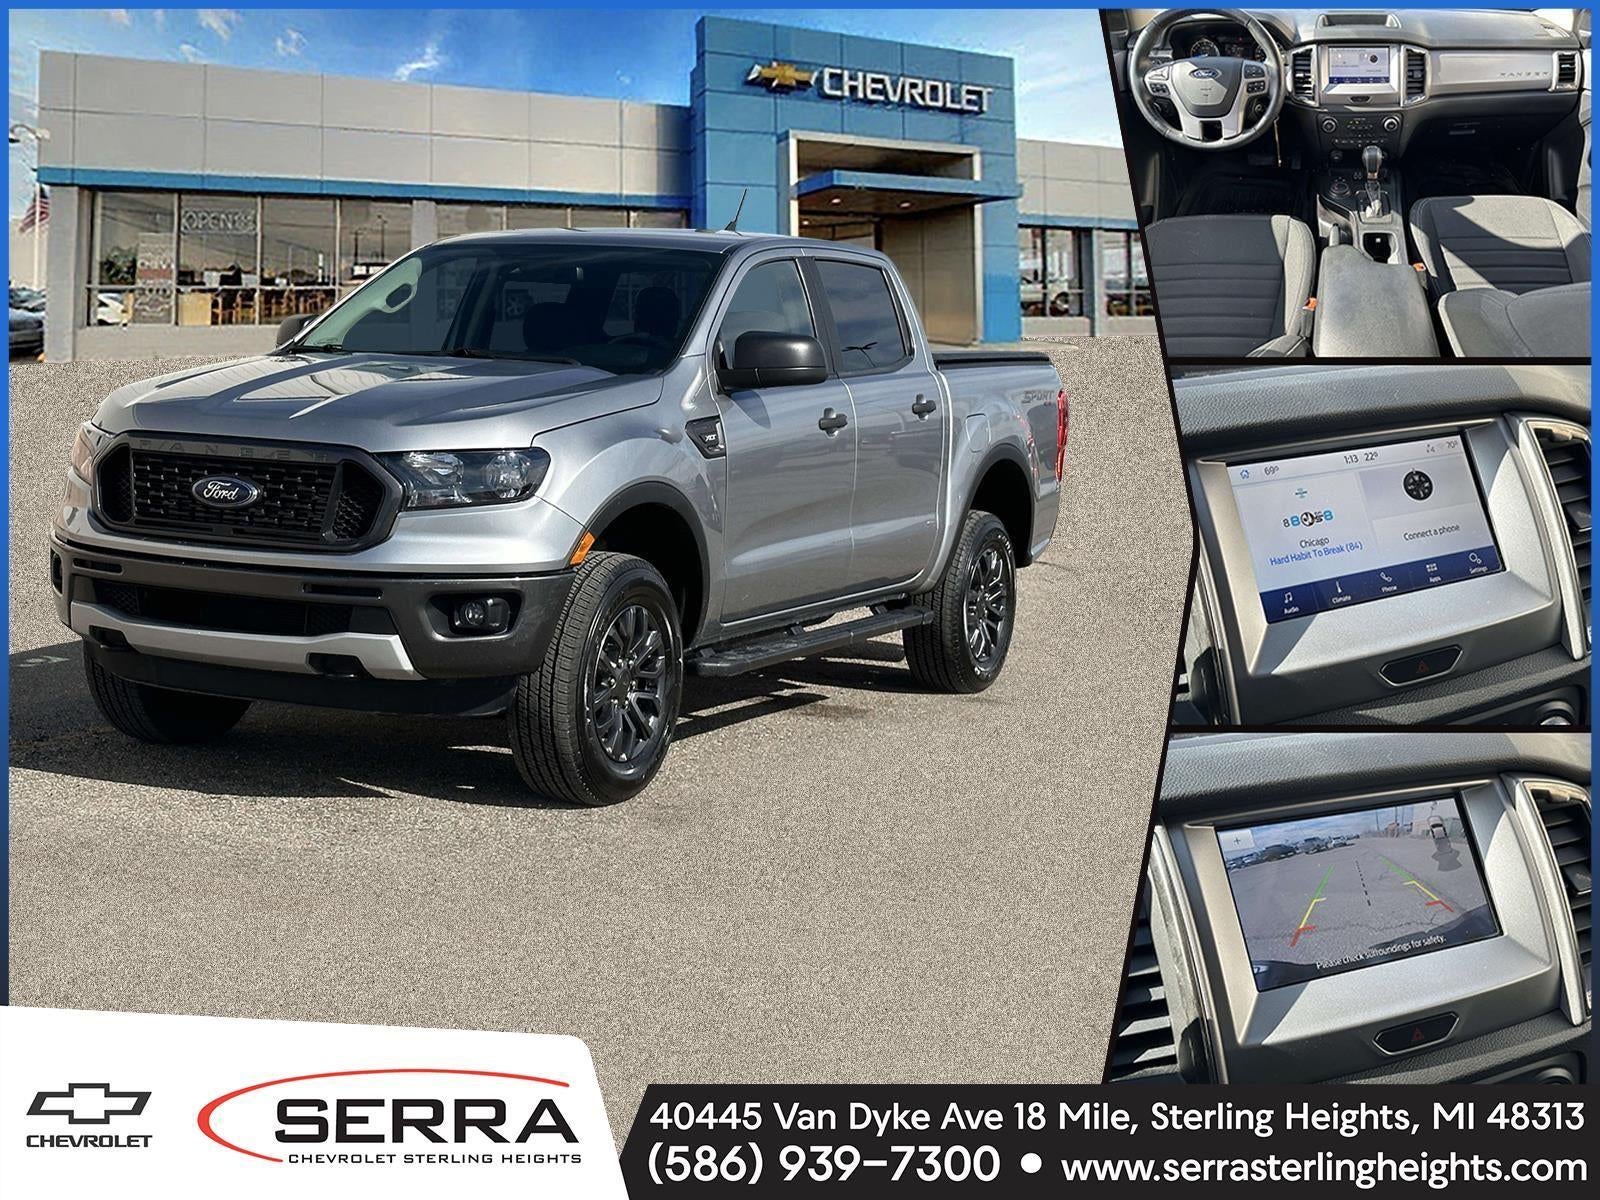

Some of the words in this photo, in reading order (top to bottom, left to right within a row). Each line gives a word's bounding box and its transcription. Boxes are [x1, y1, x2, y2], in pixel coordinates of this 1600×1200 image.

[823, 67, 993, 113] CHEVROLET
[1021, 390, 1055, 403] SPORT
[1343, 454, 1359, 465] 1:13
[203, 480, 240, 500] Ford
[1403, 529, 1433, 541] Connect
[1438, 524, 1460, 537] phone
[1300, 537, 1330, 549] Chicago
[1270, 555, 1290, 566] Hard
[1290, 551, 1312, 562] Habit
[1313, 549, 1324, 558] To
[1324, 545, 1345, 555] Break
[1346, 541, 1363, 553] (84)
[1381, 585, 1398, 593] Phone
[1332, 595, 1352, 604] Climate
[1284, 606, 1300, 615] Audio
[1316, 959, 1342, 970] Please
[1342, 952, 1365, 965] check
[1364, 941, 1412, 959] surroundings
[1411, 939, 1422, 949] for
